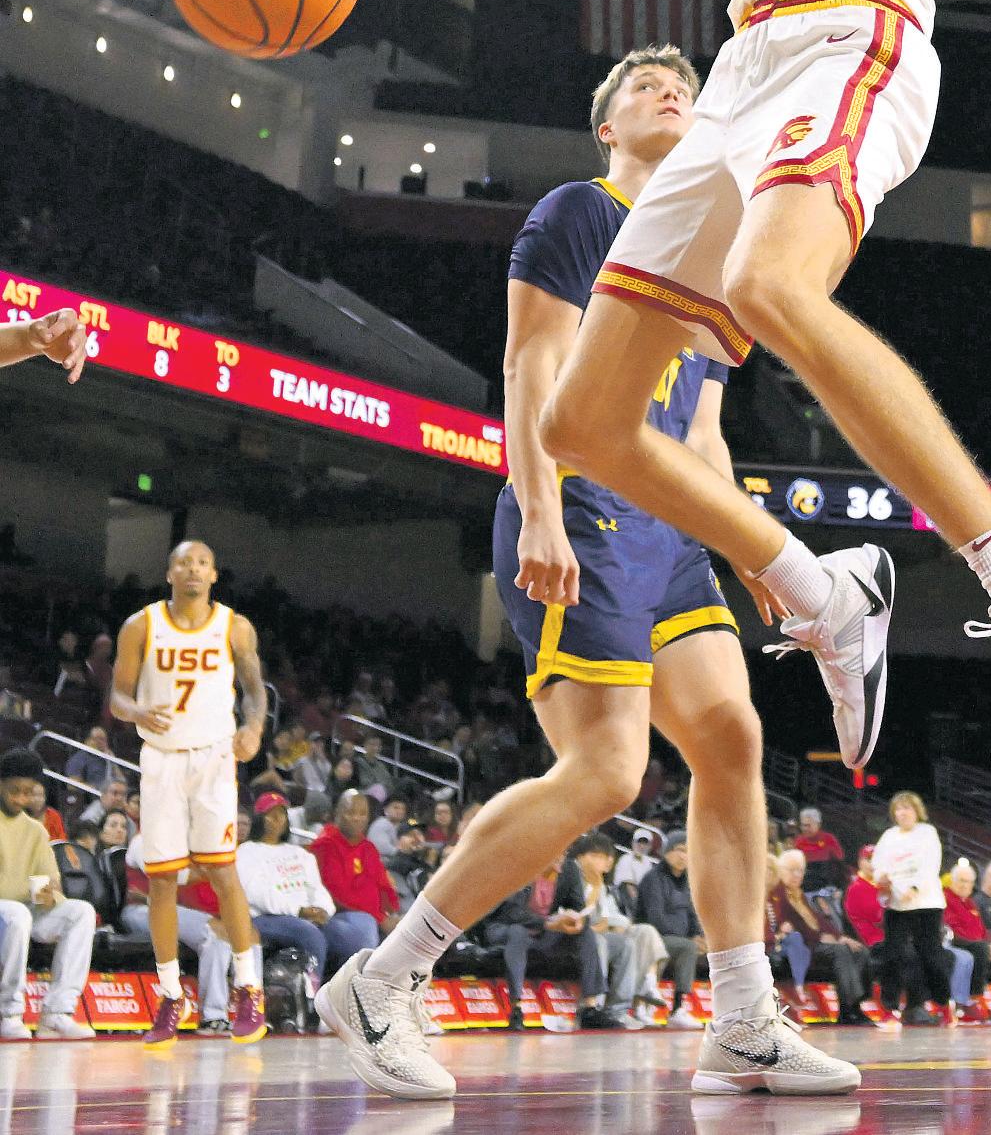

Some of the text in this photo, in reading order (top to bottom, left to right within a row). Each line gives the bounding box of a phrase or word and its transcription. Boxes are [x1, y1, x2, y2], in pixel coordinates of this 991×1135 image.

[2, 279, 41, 310] AST
[79, 301, 110, 331] STL
[147, 320, 181, 351] BLK
[214, 340, 240, 367] TO
[270, 368, 328, 411] TEAM
[329, 386, 391, 428] STATS
[419, 422, 502, 468] TROJANS
[85, 330, 231, 393] 6 8 3
[846, 486, 893, 521] 36
[156, 648, 220, 673] USC
[175, 678, 197, 713] 7
[88, 982, 136, 997] WELLS
[95, 999, 140, 1014] FARGO
